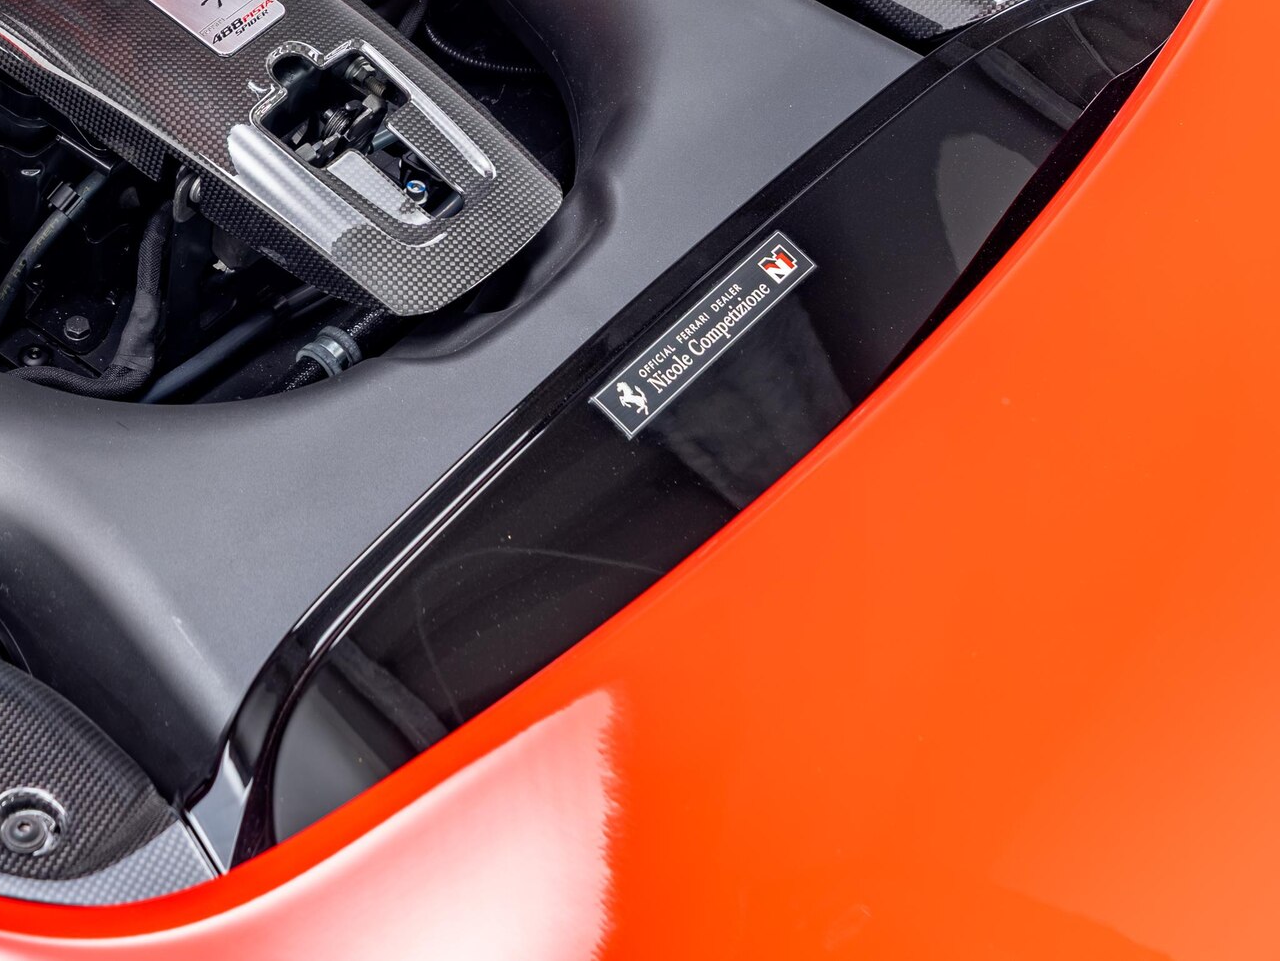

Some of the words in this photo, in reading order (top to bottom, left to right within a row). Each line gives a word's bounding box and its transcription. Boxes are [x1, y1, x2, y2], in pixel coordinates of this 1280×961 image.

[235, 9, 269, 37] SPIDER
[638, 345, 676, 378] OFFICIAL
[676, 312, 710, 344] FERRARI
[710, 283, 743, 313] DEALER
[646, 354, 694, 394] Nicole
[688, 283, 770, 356] Competizione
